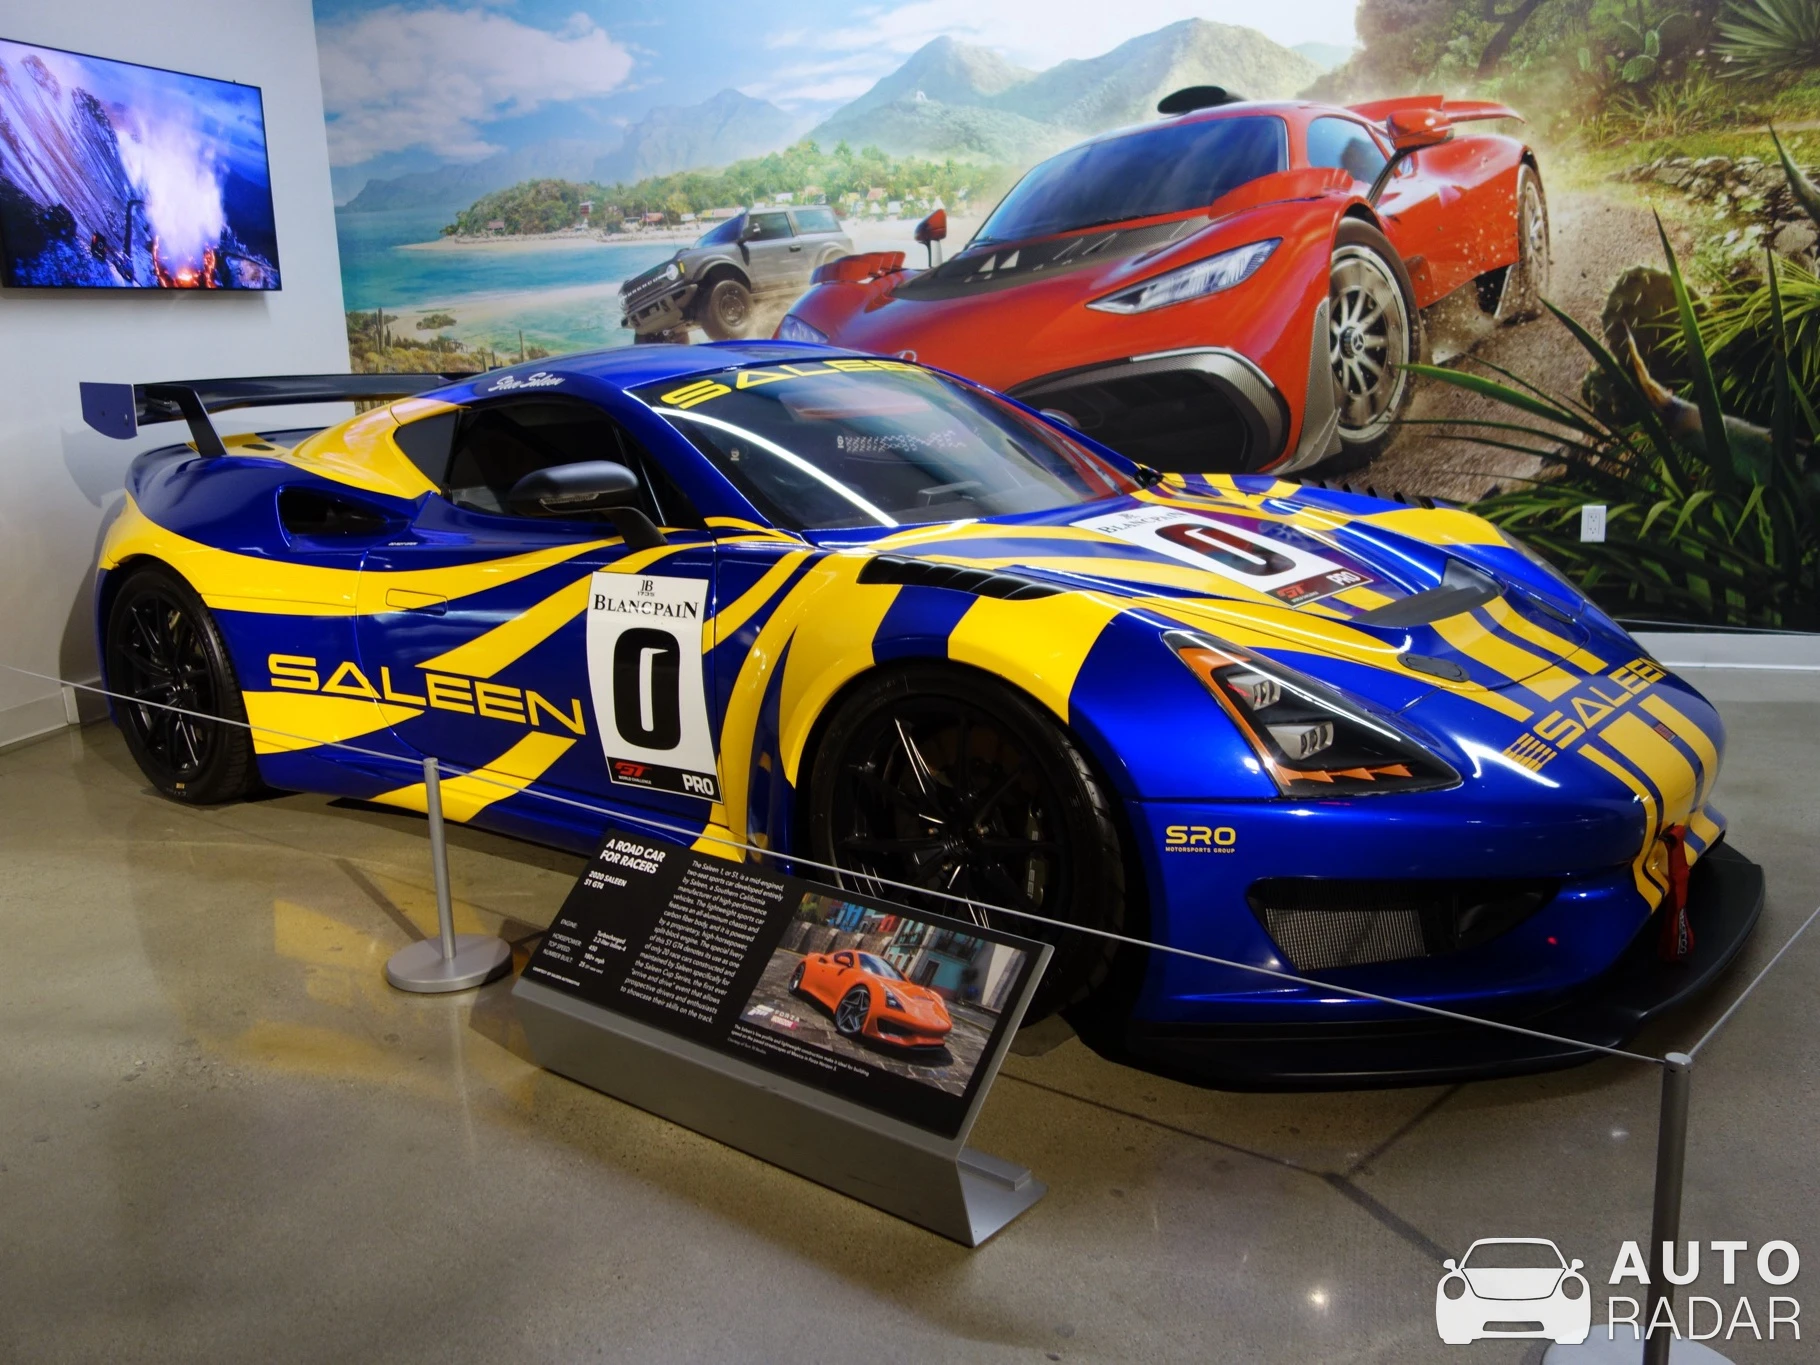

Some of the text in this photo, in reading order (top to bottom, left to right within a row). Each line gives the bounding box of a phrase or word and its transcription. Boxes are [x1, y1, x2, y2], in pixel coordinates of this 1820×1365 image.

[1155, 523, 1296, 576] 0
[594, 594, 698, 618] BLANCPAIN
[268, 653, 586, 736] SALEEN
[613, 628, 681, 750] 0
[682, 774, 714, 796] PRO
[1165, 826, 1236, 846] SRO
[600, 850, 658, 873] FOR RACERS
[606, 839, 666, 862] A ROAD CAR
[589, 871, 627, 886] 2020 SALEEN
[702, 863, 719, 872] Saleen
[592, 881, 604, 889] GT4
[682, 877, 690, 885] by
[714, 886, 739, 897] Southern
[739, 893, 766, 905] California
[687, 869, 709, 879] two-seat
[709, 876, 726, 884] sports
[734, 882, 764, 894] developed
[763, 891, 784, 901] entirely
[678, 886, 712, 899] manufacturer
[719, 897, 767, 915] high-performance
[696, 899, 706, 908] The
[707, 903, 737, 916] lightweight
[737, 913, 755, 922] sports
[659, 917, 666, 926] by
[664, 911, 682, 919] carbon
[682, 915, 694, 923] fiber
[729, 931, 755, 942] powered
[669, 901, 689, 912] features
[696, 910, 728, 923] all-aluminum
[729, 920, 748, 930] chassis
[654, 927, 680, 938] split-block
[700, 940, 710, 948] The
[710, 945, 730, 954] special
[729, 949, 744, 960] livery
[672, 941, 684, 949] GT4
[683, 946, 704, 957] denotes
[640, 952, 669, 965] maintained
[668, 960, 675, 969] by
[675, 962, 693, 973] Saleen
[693, 970, 722, 984] specifically
[650, 946, 662, 954] only
[693, 960, 725, 973] constructed
[644, 962, 662, 973] Saleen
[662, 969, 674, 978] Cup
[703, 982, 715, 991] first
[624, 978, 656, 992] prospective
[656, 988, 675, 999] drivers
[687, 1000, 718, 1014] enthusiasts
[627, 988, 652, 1001] showcase
[652, 997, 666, 1005] their
[666, 1002, 679, 1011] skills
[675, 985, 691, 994] event
[691, 989, 703, 998] that
[702, 994, 720, 1004] allows
[775, 1010, 800, 1023] FORZA
